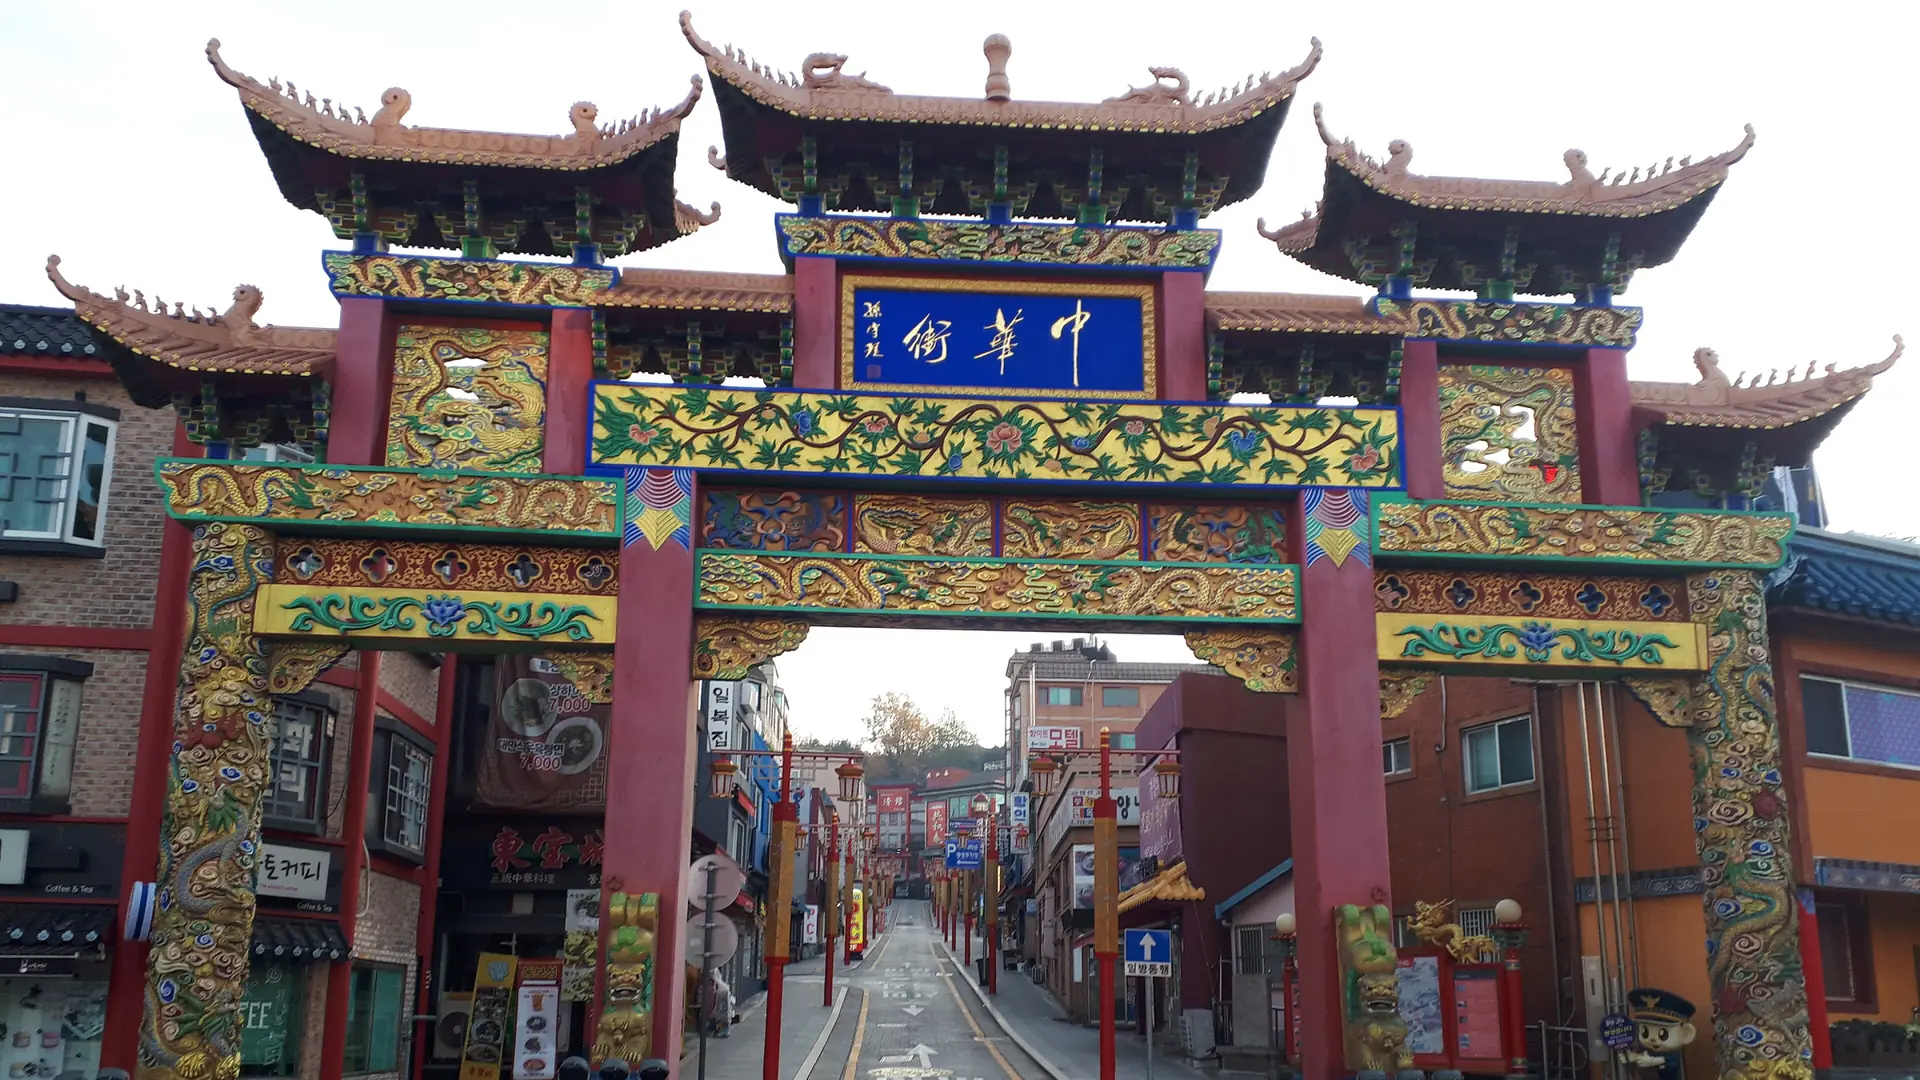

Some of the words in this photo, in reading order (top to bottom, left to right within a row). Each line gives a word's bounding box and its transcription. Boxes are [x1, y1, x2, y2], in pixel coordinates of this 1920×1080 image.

[549, 698, 591, 713] 7,000
[520, 755, 561, 770] 7,000
[45, 883, 70, 894] Coffee
[1127, 963, 1169, 976] 일방통행
